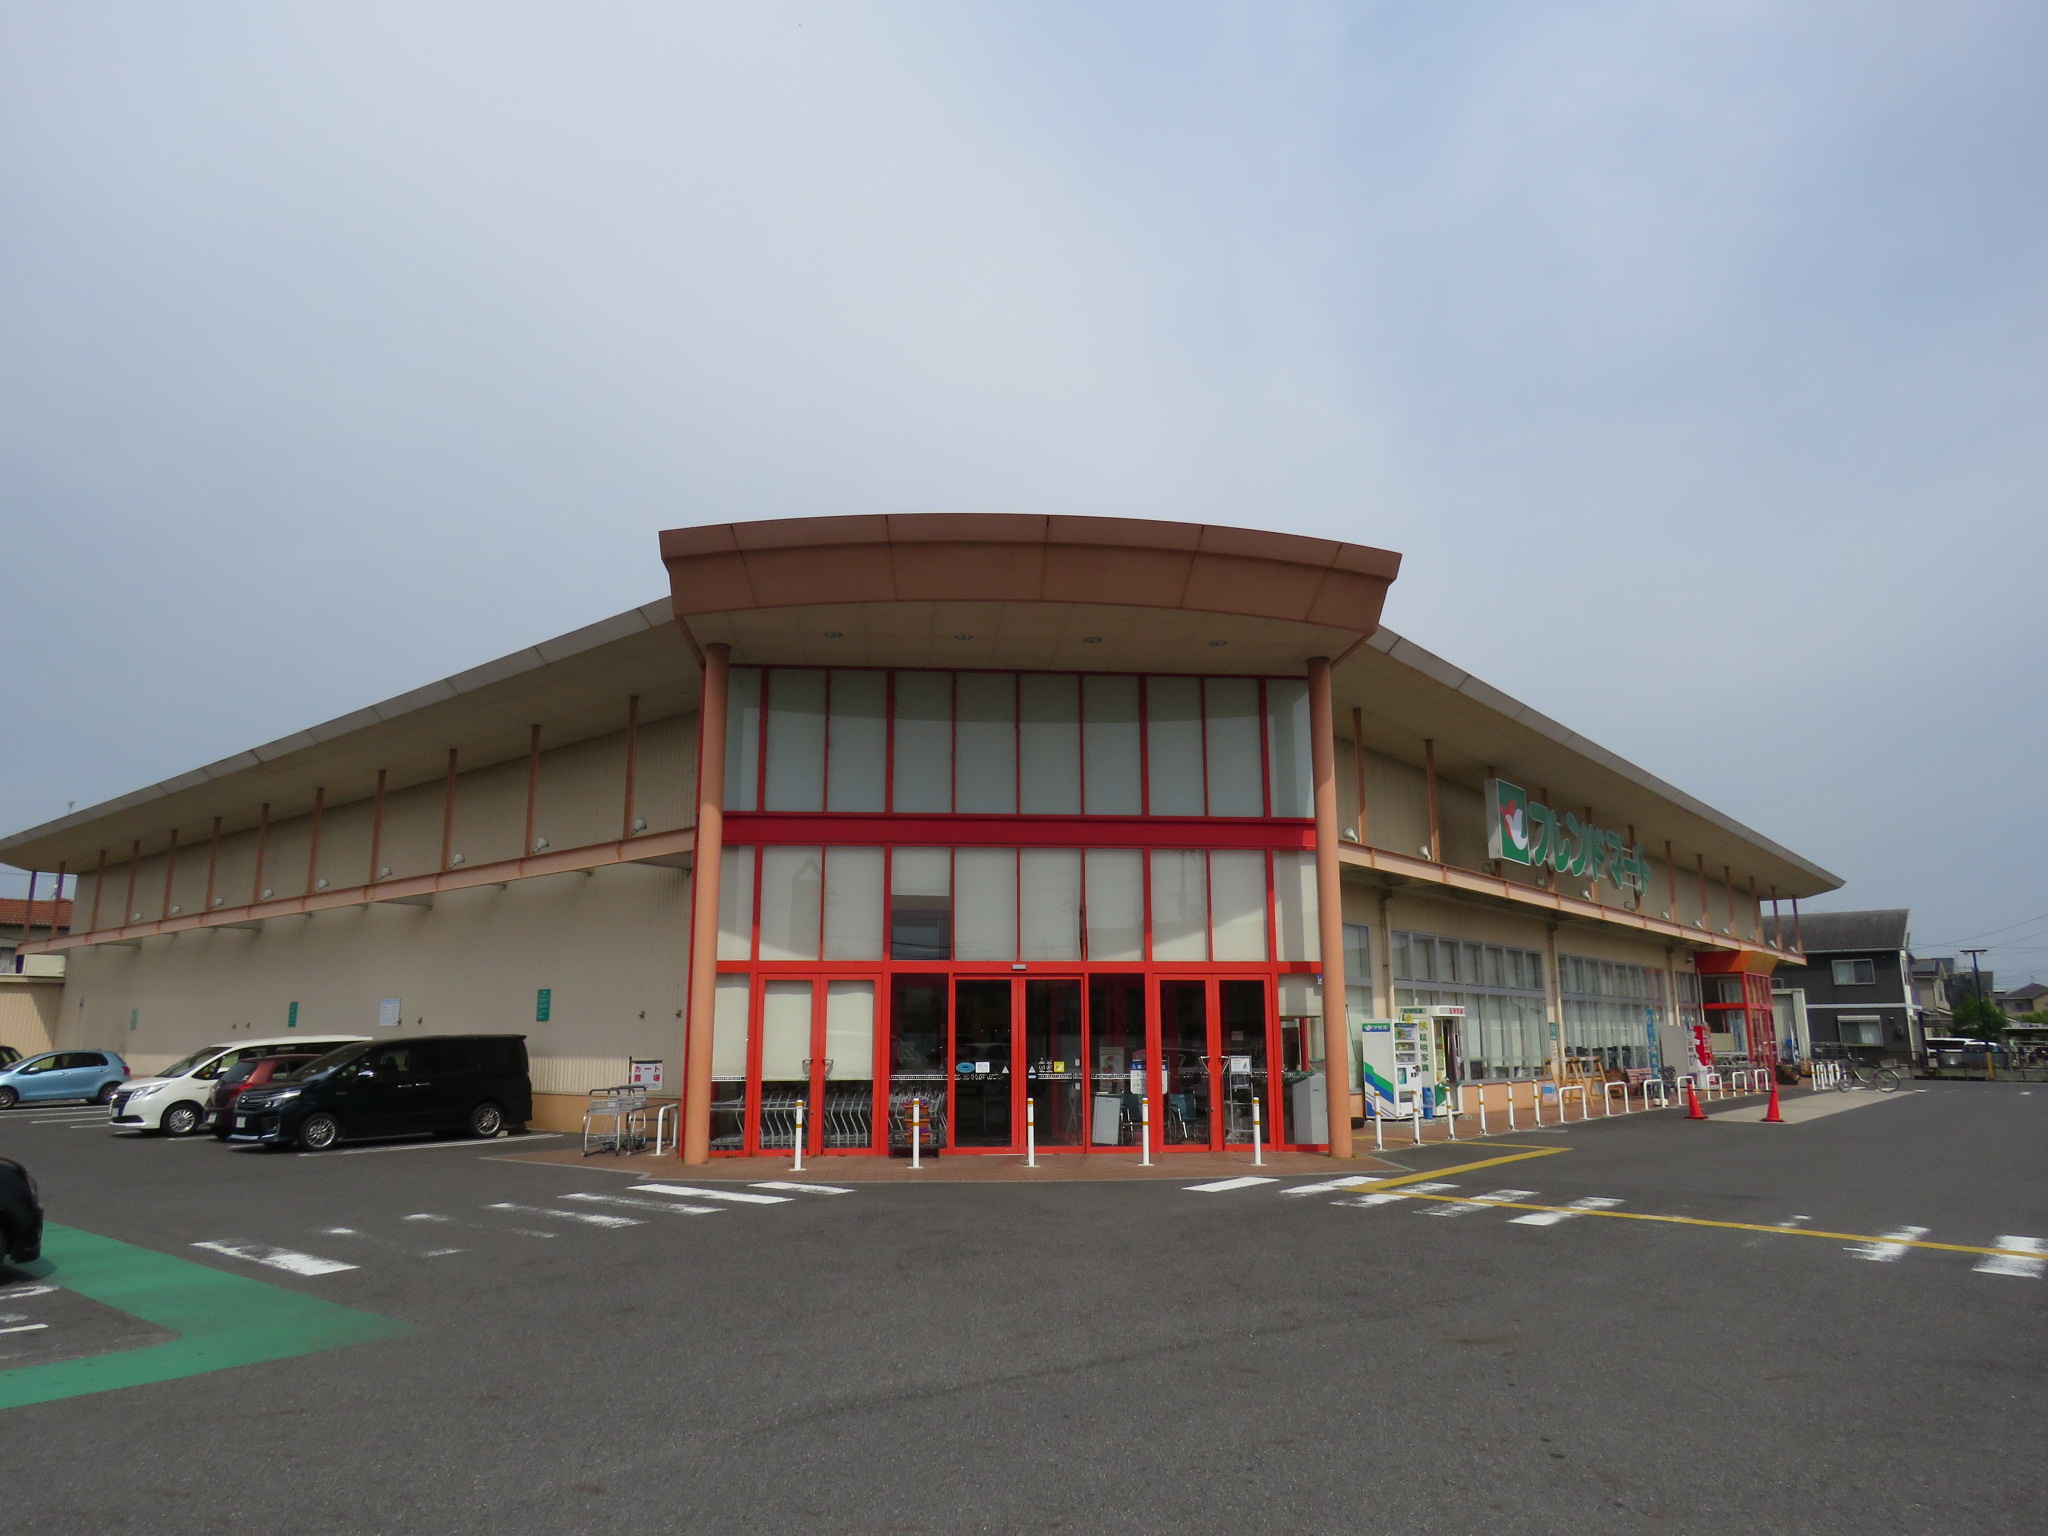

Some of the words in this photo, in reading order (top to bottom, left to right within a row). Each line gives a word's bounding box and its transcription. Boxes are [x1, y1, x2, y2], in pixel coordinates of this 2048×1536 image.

[1528, 801, 1652, 896] フレンドマート
